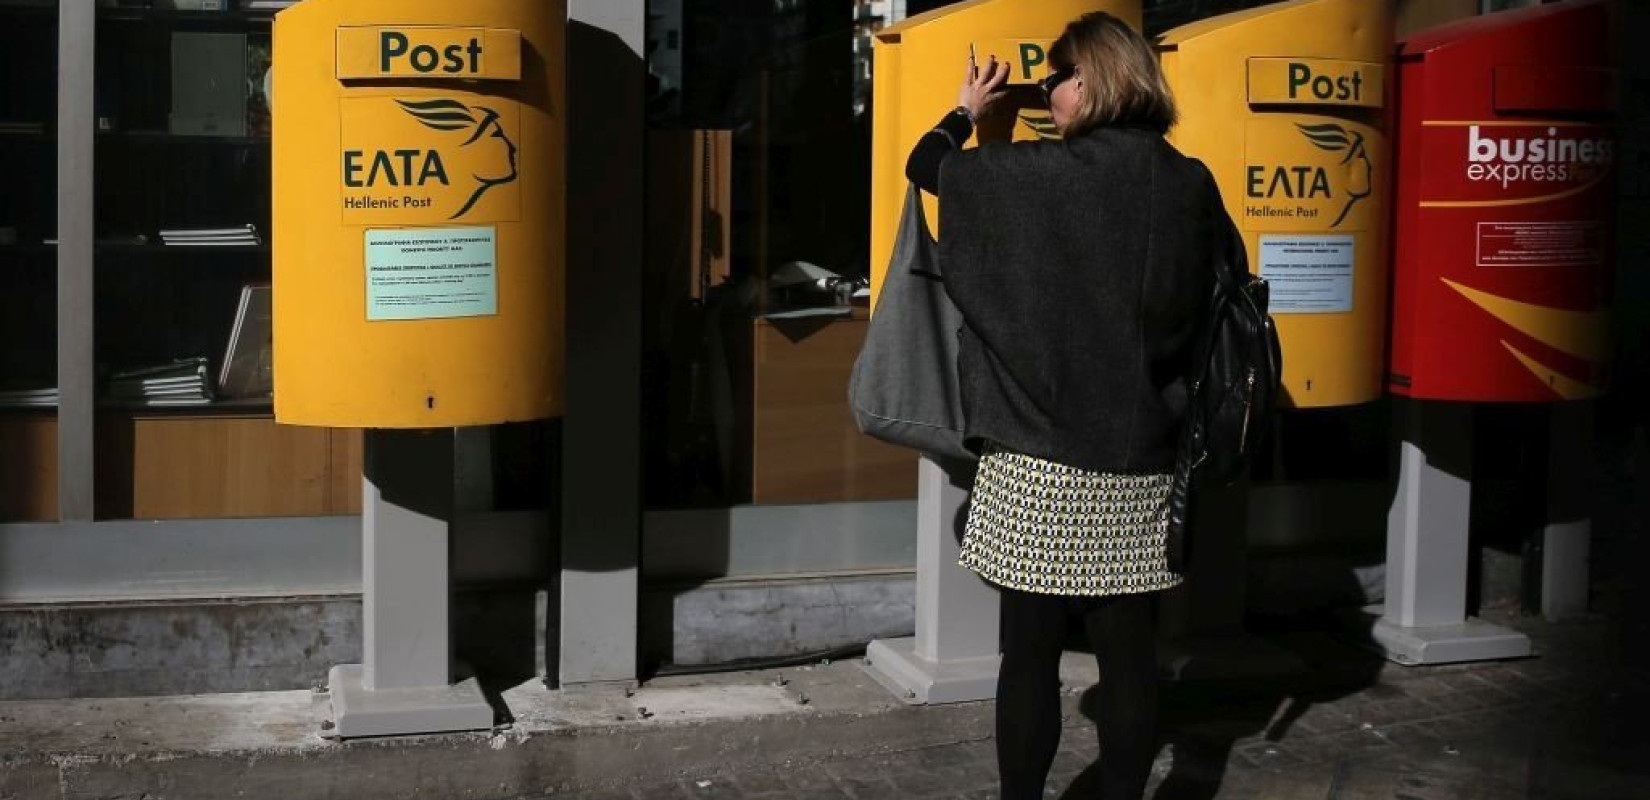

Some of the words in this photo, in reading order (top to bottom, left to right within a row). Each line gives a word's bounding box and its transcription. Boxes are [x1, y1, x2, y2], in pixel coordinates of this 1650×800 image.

[381, 31, 482, 73] Post
[1288, 62, 1361, 101] Post
[344, 149, 449, 188] ΕΛΤΑ
[1246, 165, 1331, 199] ΕΛΤΑ
[1467, 163, 1568, 190] express
[344, 196, 399, 209] Hellenic
[403, 196, 432, 208] Post
[1246, 205, 1294, 217] Hellenic
[1296, 206, 1318, 217] Post
